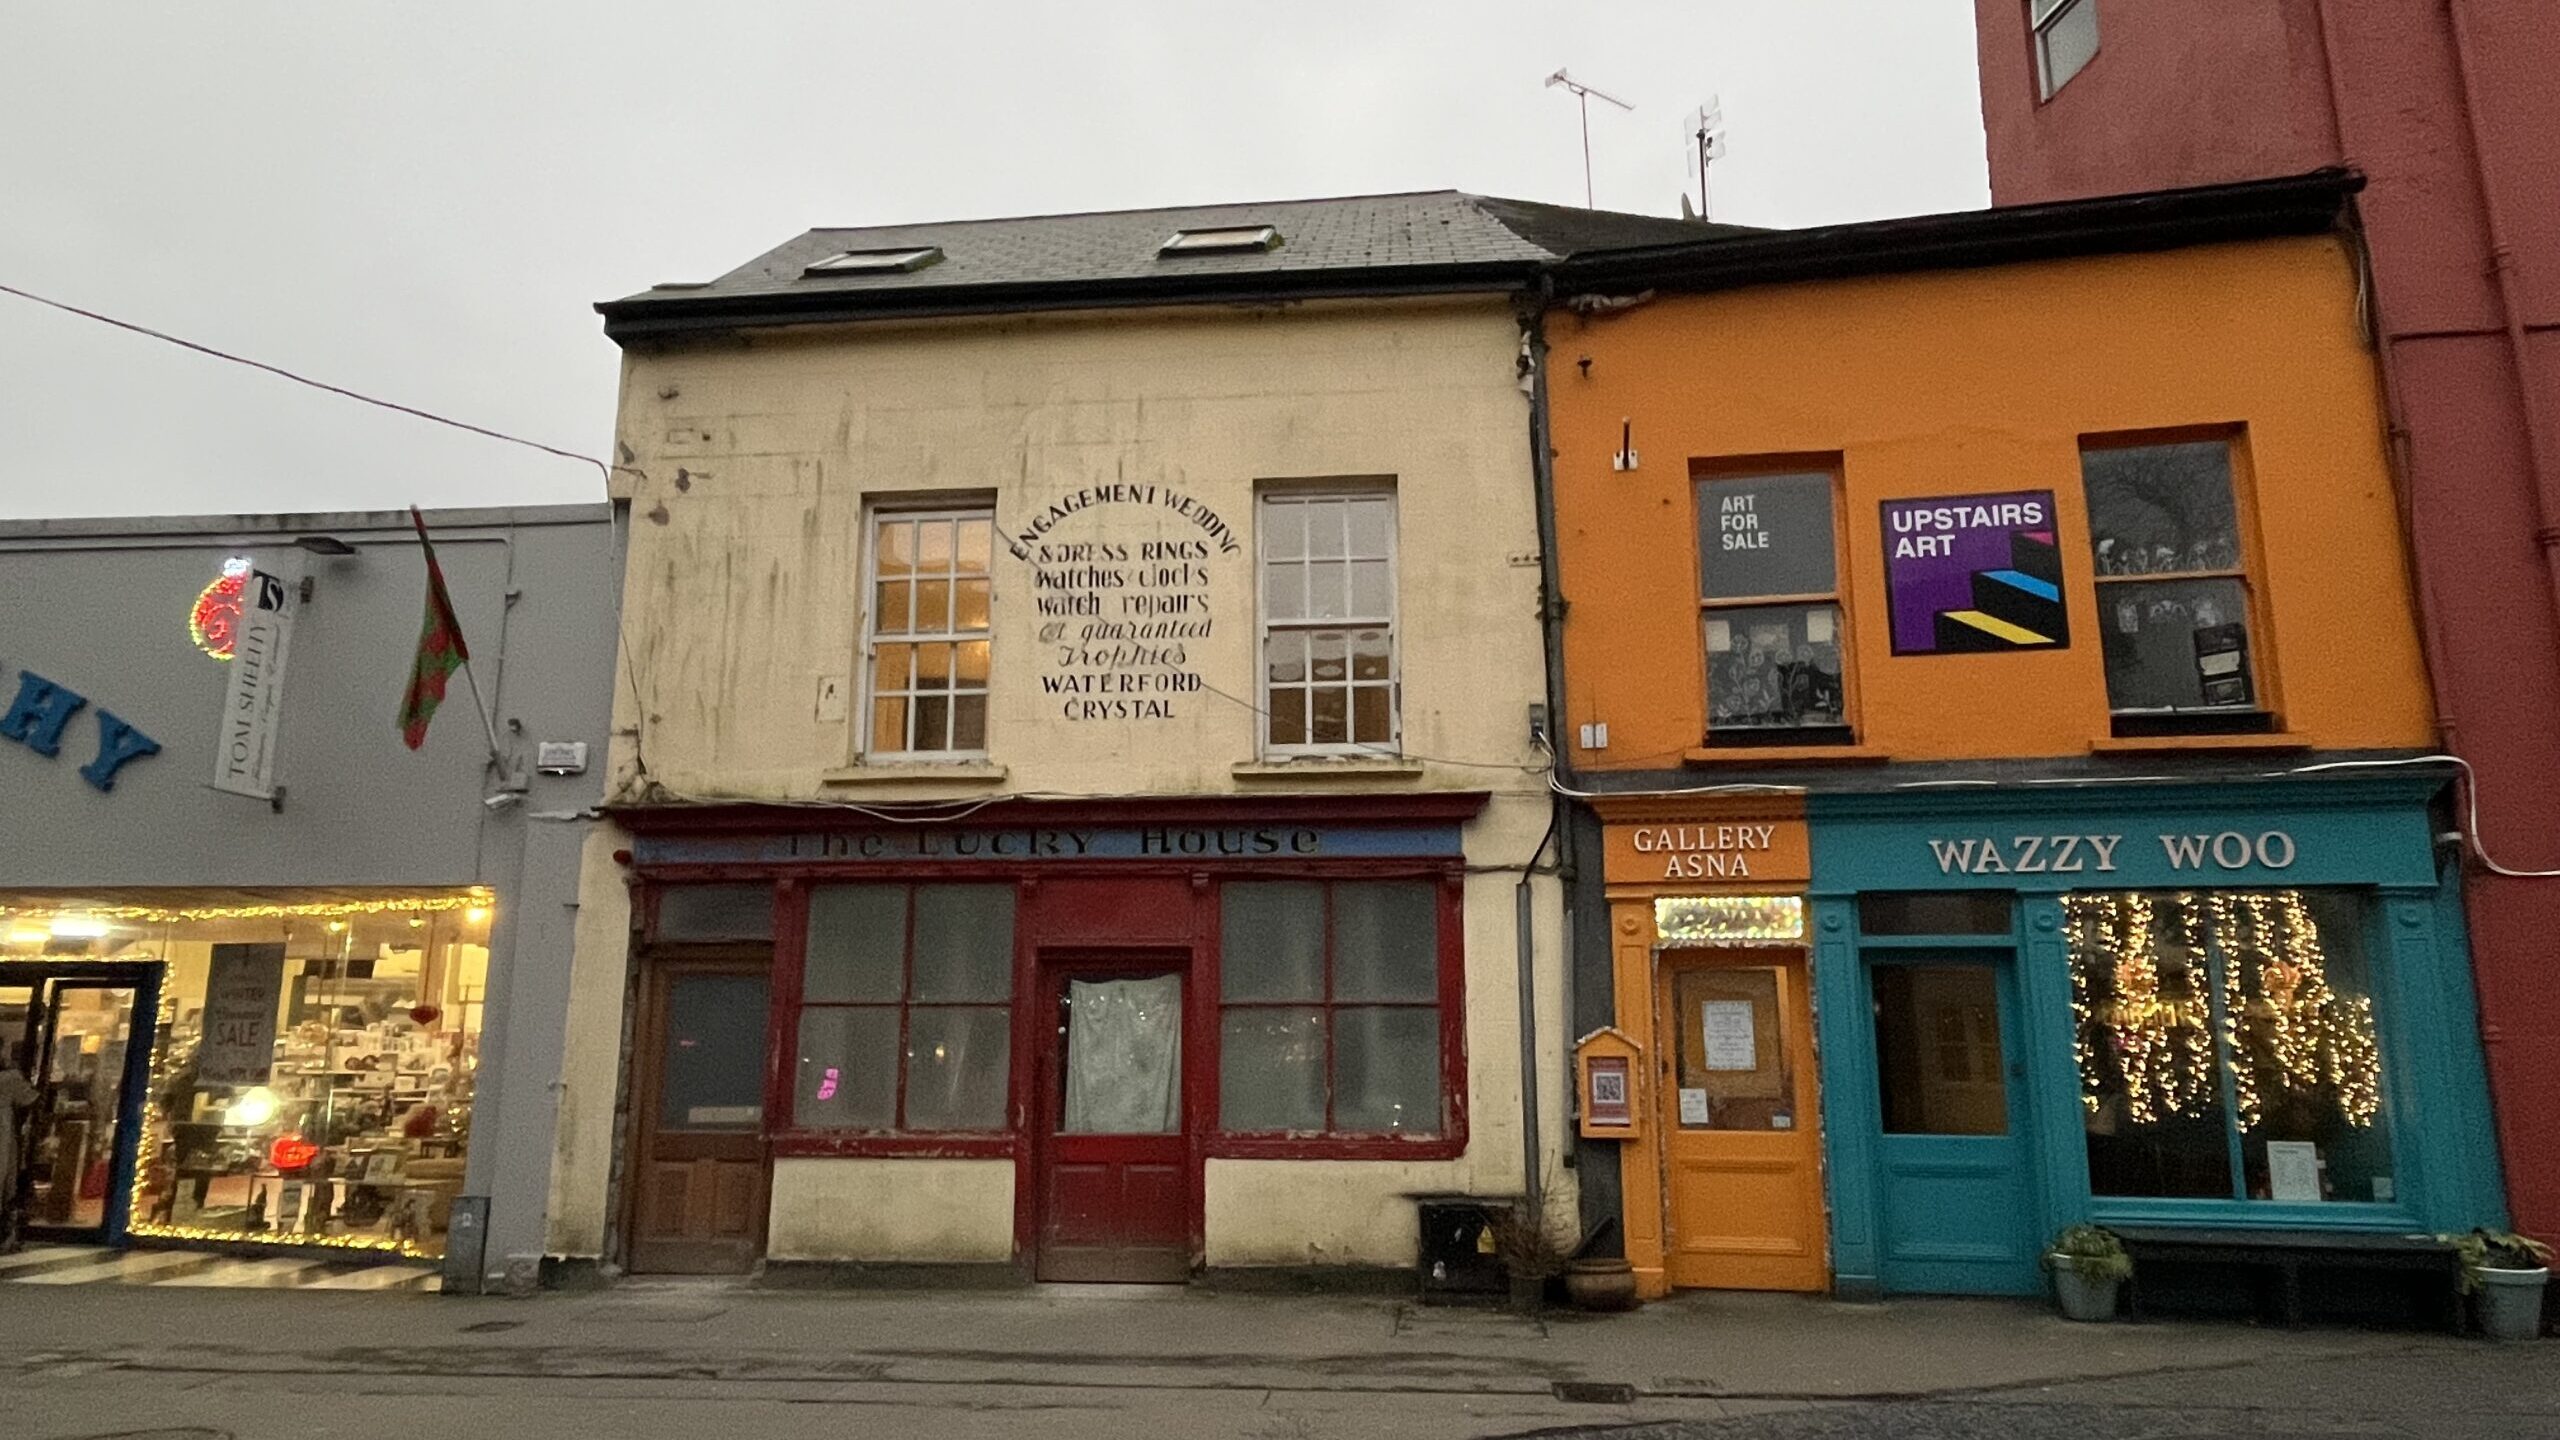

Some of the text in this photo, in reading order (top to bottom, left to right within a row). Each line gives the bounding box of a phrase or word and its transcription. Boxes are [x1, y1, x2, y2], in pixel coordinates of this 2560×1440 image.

[1721, 495, 1755, 513] ART
[1009, 484, 1242, 561] ENGAGEMENT WEDDING
[1721, 514, 1758, 531] FOR
[1892, 502, 2043, 532] UPSTAIRS
[1039, 540, 1209, 564] & DRESS RINGS
[1722, 532, 1769, 550] SALE
[1895, 534, 1955, 558] ART
[1035, 564, 1124, 590] watches
[1037, 591, 1209, 619] watch repairs
[1080, 618, 1212, 646] guaranteed
[1058, 643, 1187, 672] Trophies
[1042, 672, 1201, 694] WATERFORD
[1063, 698, 1175, 722] CRYSTAL
[230, 719, 253, 779] TOM
[1633, 825, 1776, 851] GALLERY
[1928, 830, 2297, 874] WAZZY WOO
[1664, 853, 1750, 878] ASNA
[216, 1022, 257, 1047] SALE
